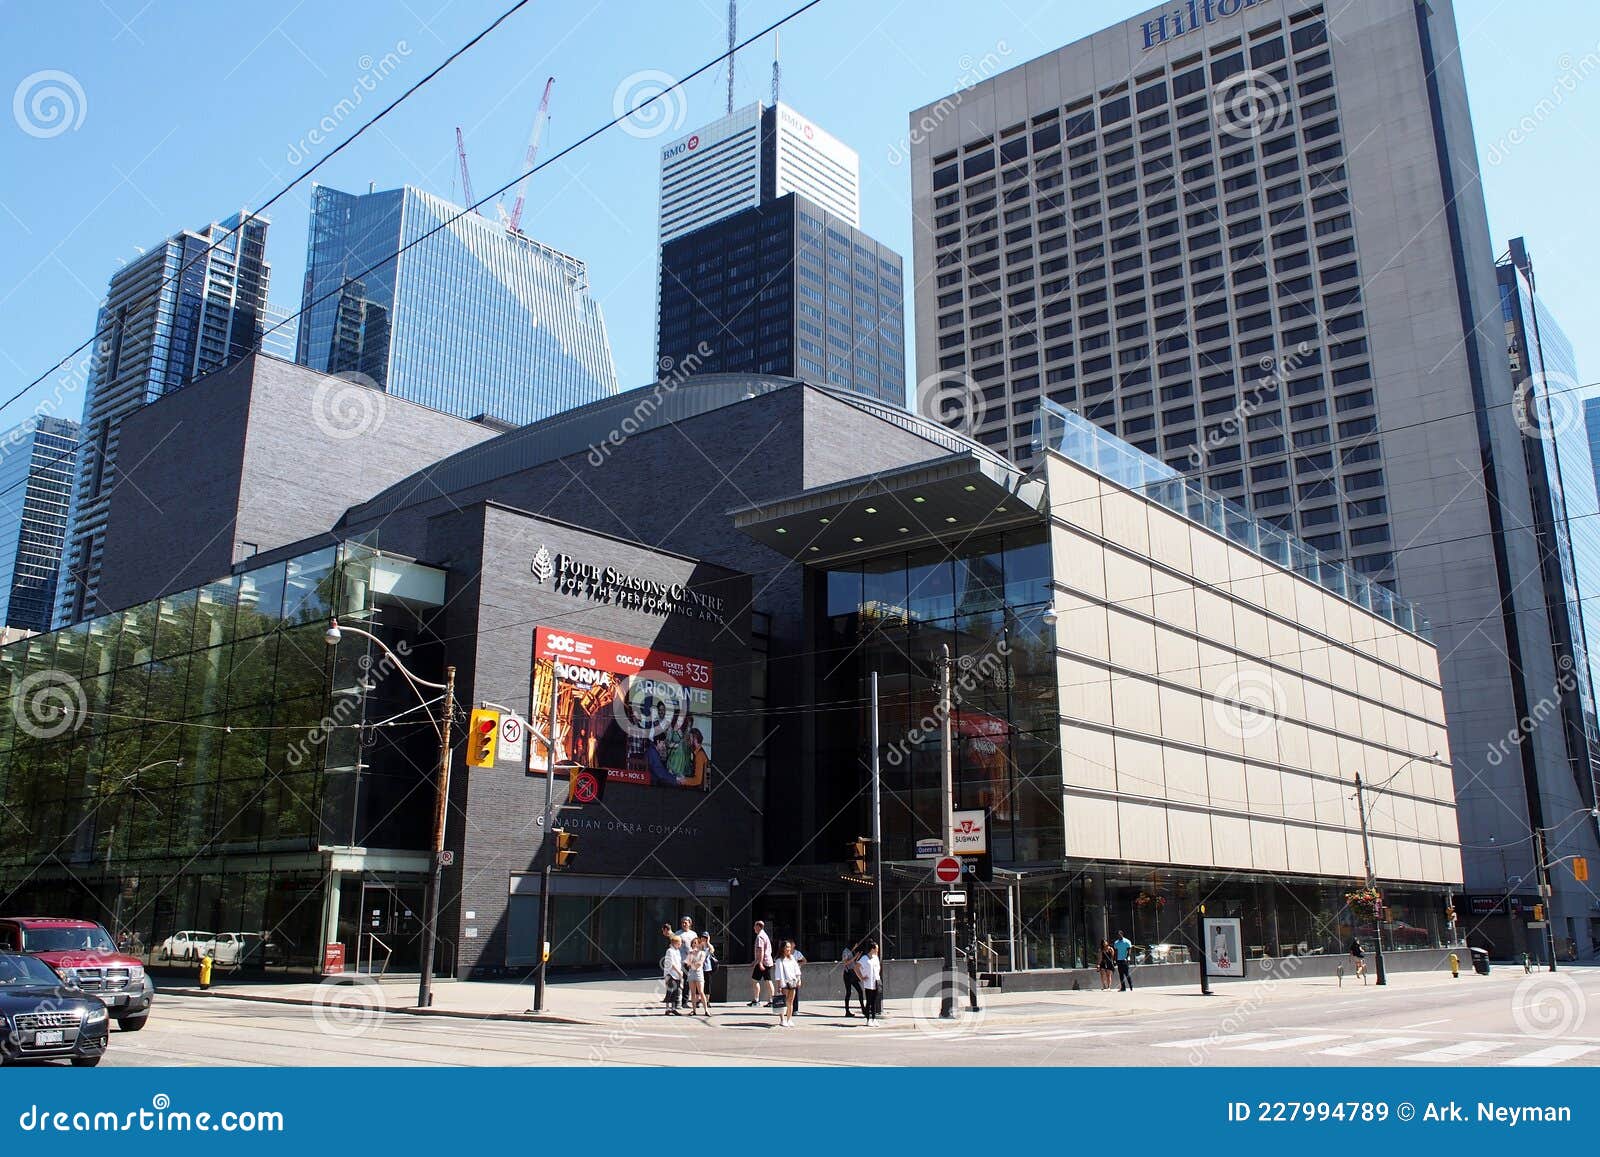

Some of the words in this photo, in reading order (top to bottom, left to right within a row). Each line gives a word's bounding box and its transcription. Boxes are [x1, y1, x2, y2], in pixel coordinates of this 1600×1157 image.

[663, 143, 686, 161] BMO
[560, 554, 600, 580] FOUR
[606, 566, 667, 596] SEASONS
[671, 583, 724, 611] CENTRE
[560, 576, 583, 591] FOR
[592, 583, 614, 599] THE
[620, 590, 693, 617] PERFORMING
[699, 612, 724, 625] ARTS
[616, 654, 645, 667] coc.ca
[662, 660, 684, 670] TICKETS
[557, 663, 610, 688] NORMA
[668, 669, 684, 677] FROM
[686, 662, 709, 683] $35
[537, 815, 600, 830] CNADIAN
[608, 821, 643, 833] OPERA
[649, 823, 698, 836] COMPANY
